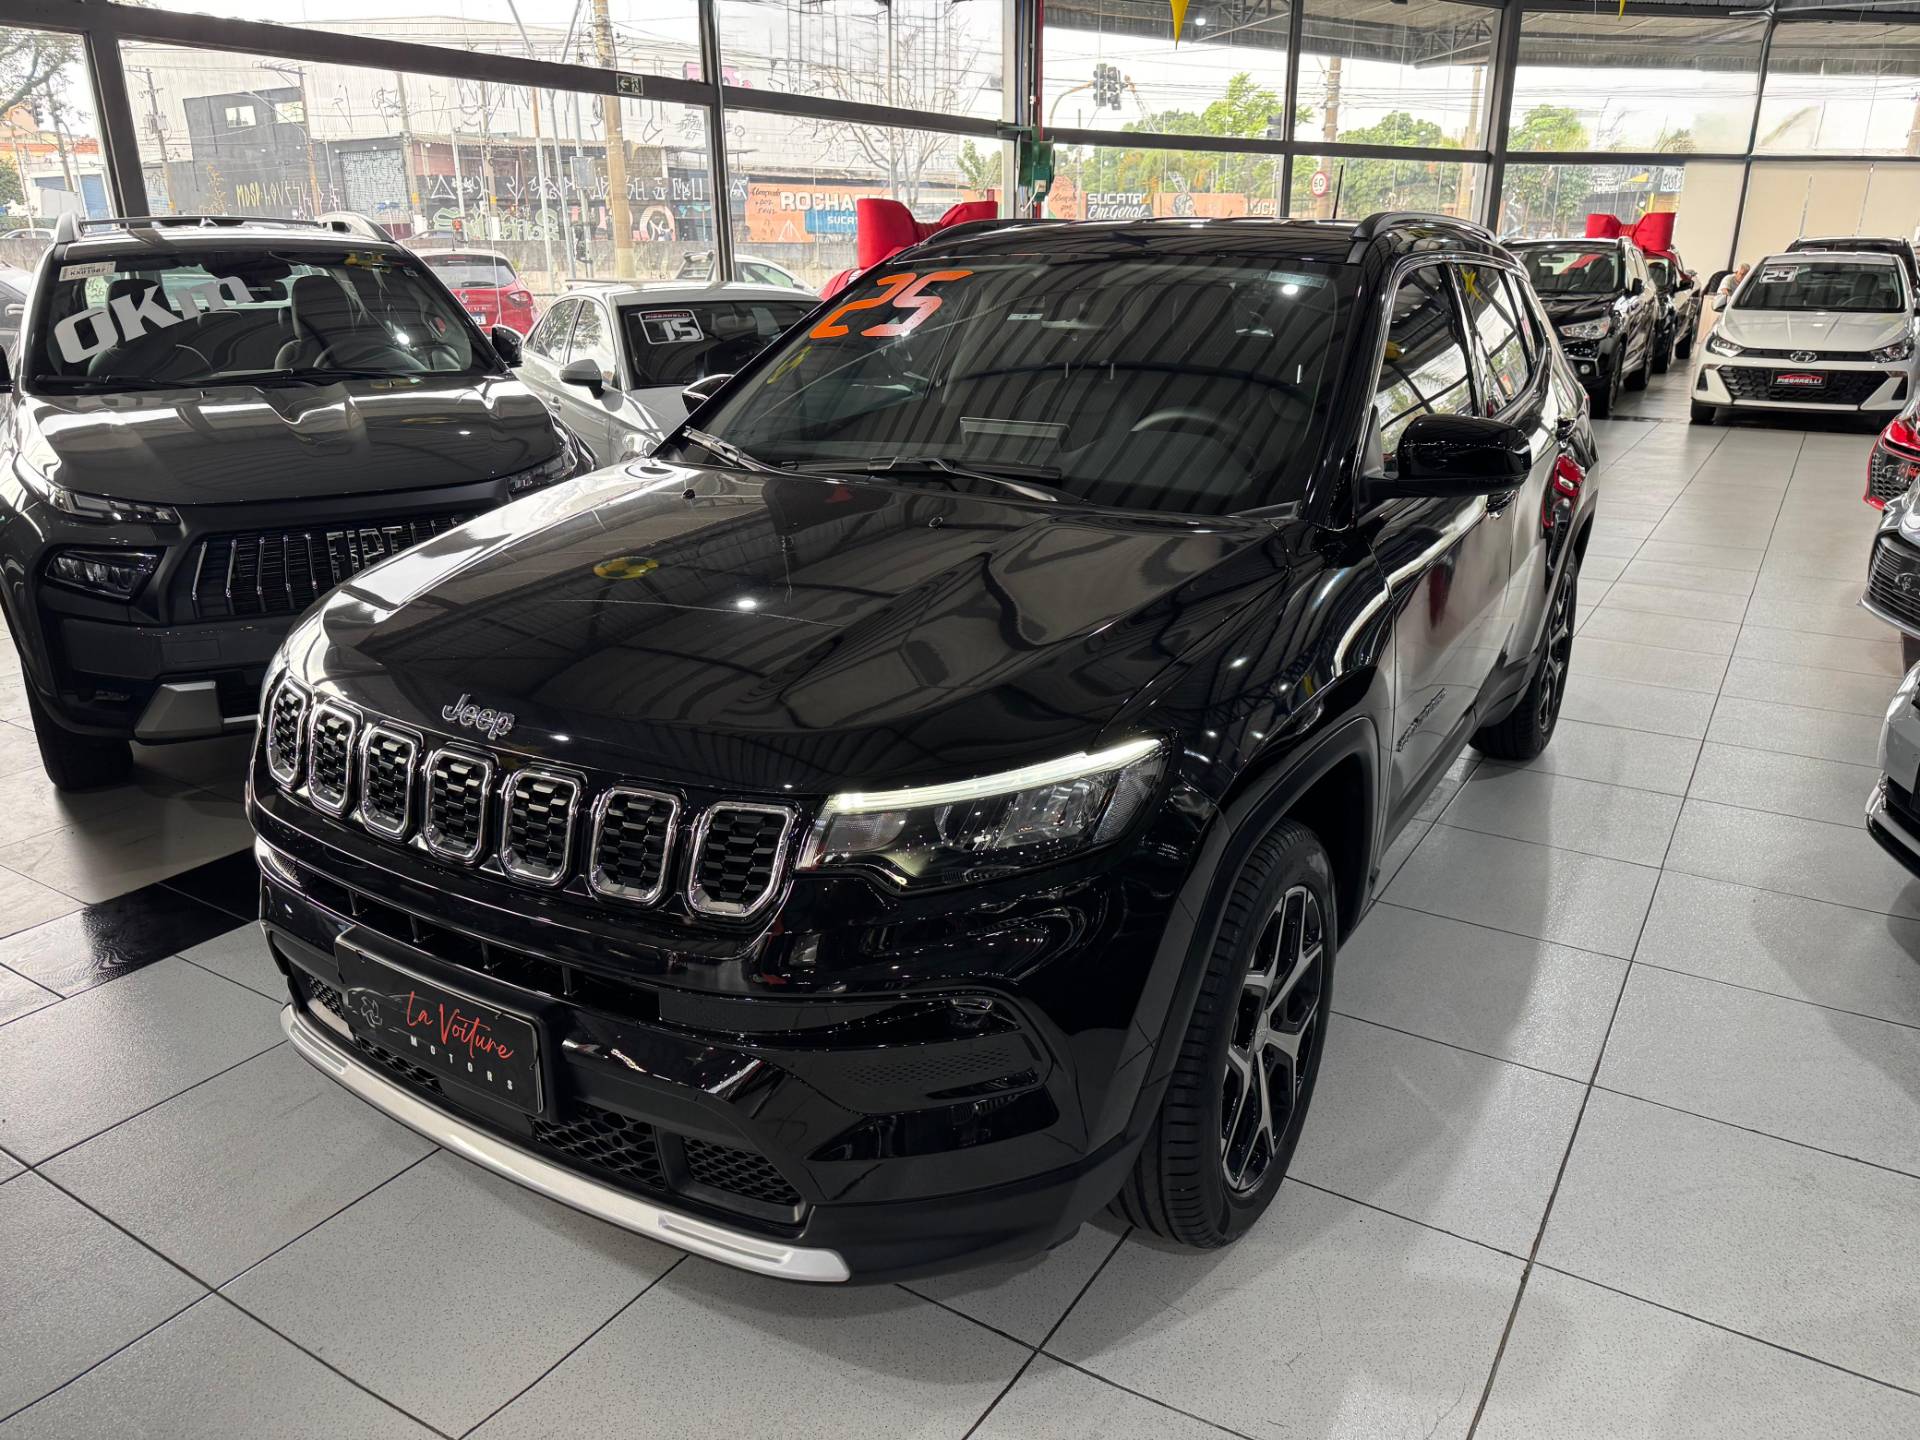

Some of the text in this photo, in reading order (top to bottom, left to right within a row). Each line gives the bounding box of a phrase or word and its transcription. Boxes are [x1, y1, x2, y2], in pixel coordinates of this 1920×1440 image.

[809, 270, 974, 339] 25
[326, 525, 403, 585] FIAT
[441, 693, 515, 741] Jeep
[406, 990, 515, 1061] La Voiture
[410, 1035, 514, 1091] MOTORS
